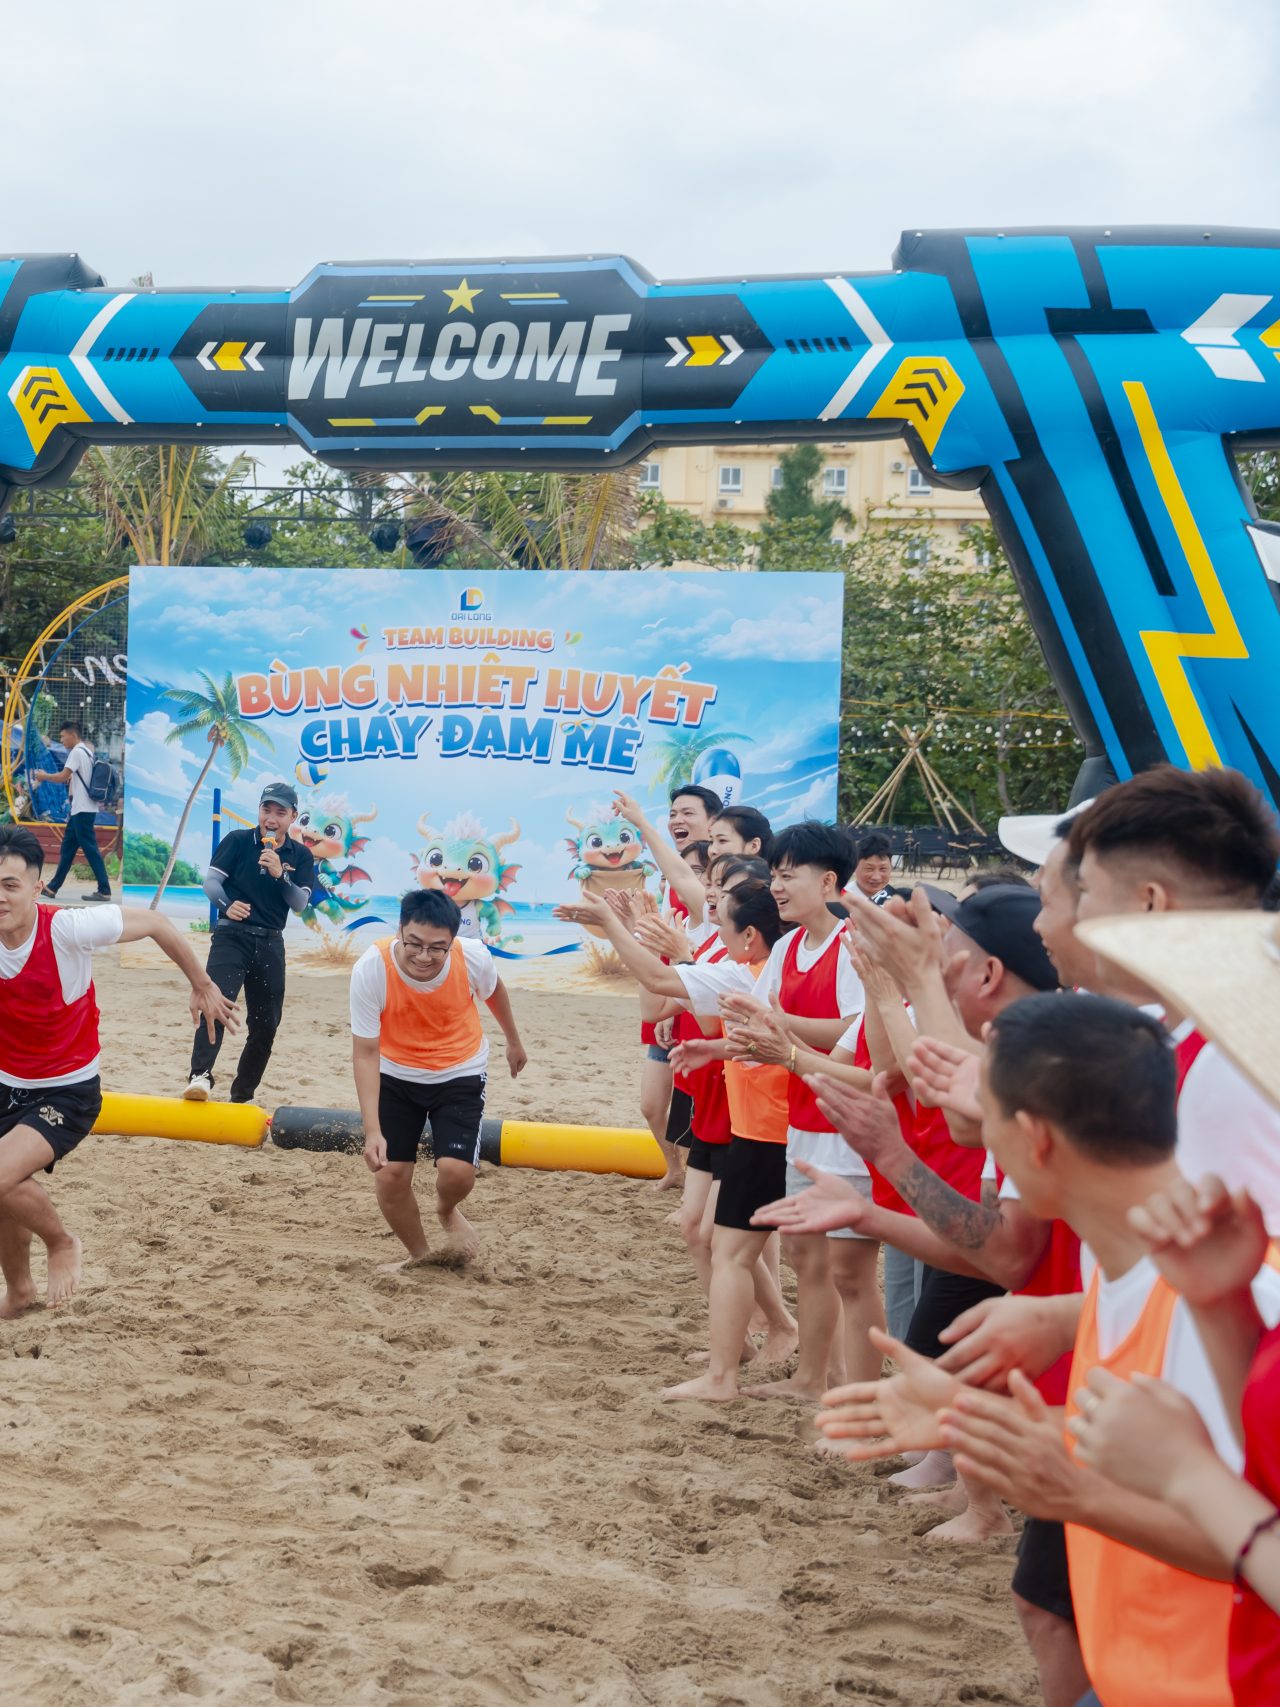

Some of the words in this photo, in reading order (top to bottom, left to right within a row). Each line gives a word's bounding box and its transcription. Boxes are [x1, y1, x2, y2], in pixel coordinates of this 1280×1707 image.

[288, 313, 632, 400] WELCOME
[383, 626, 444, 648] TEAM
[448, 627, 554, 651] BUILDING
[468, 612, 492, 621] LONG
[236, 658, 378, 716] BÙNG
[544, 661, 716, 725] HUYẾT
[300, 704, 430, 761] CHÁY
[562, 716, 642, 771] MÊ
